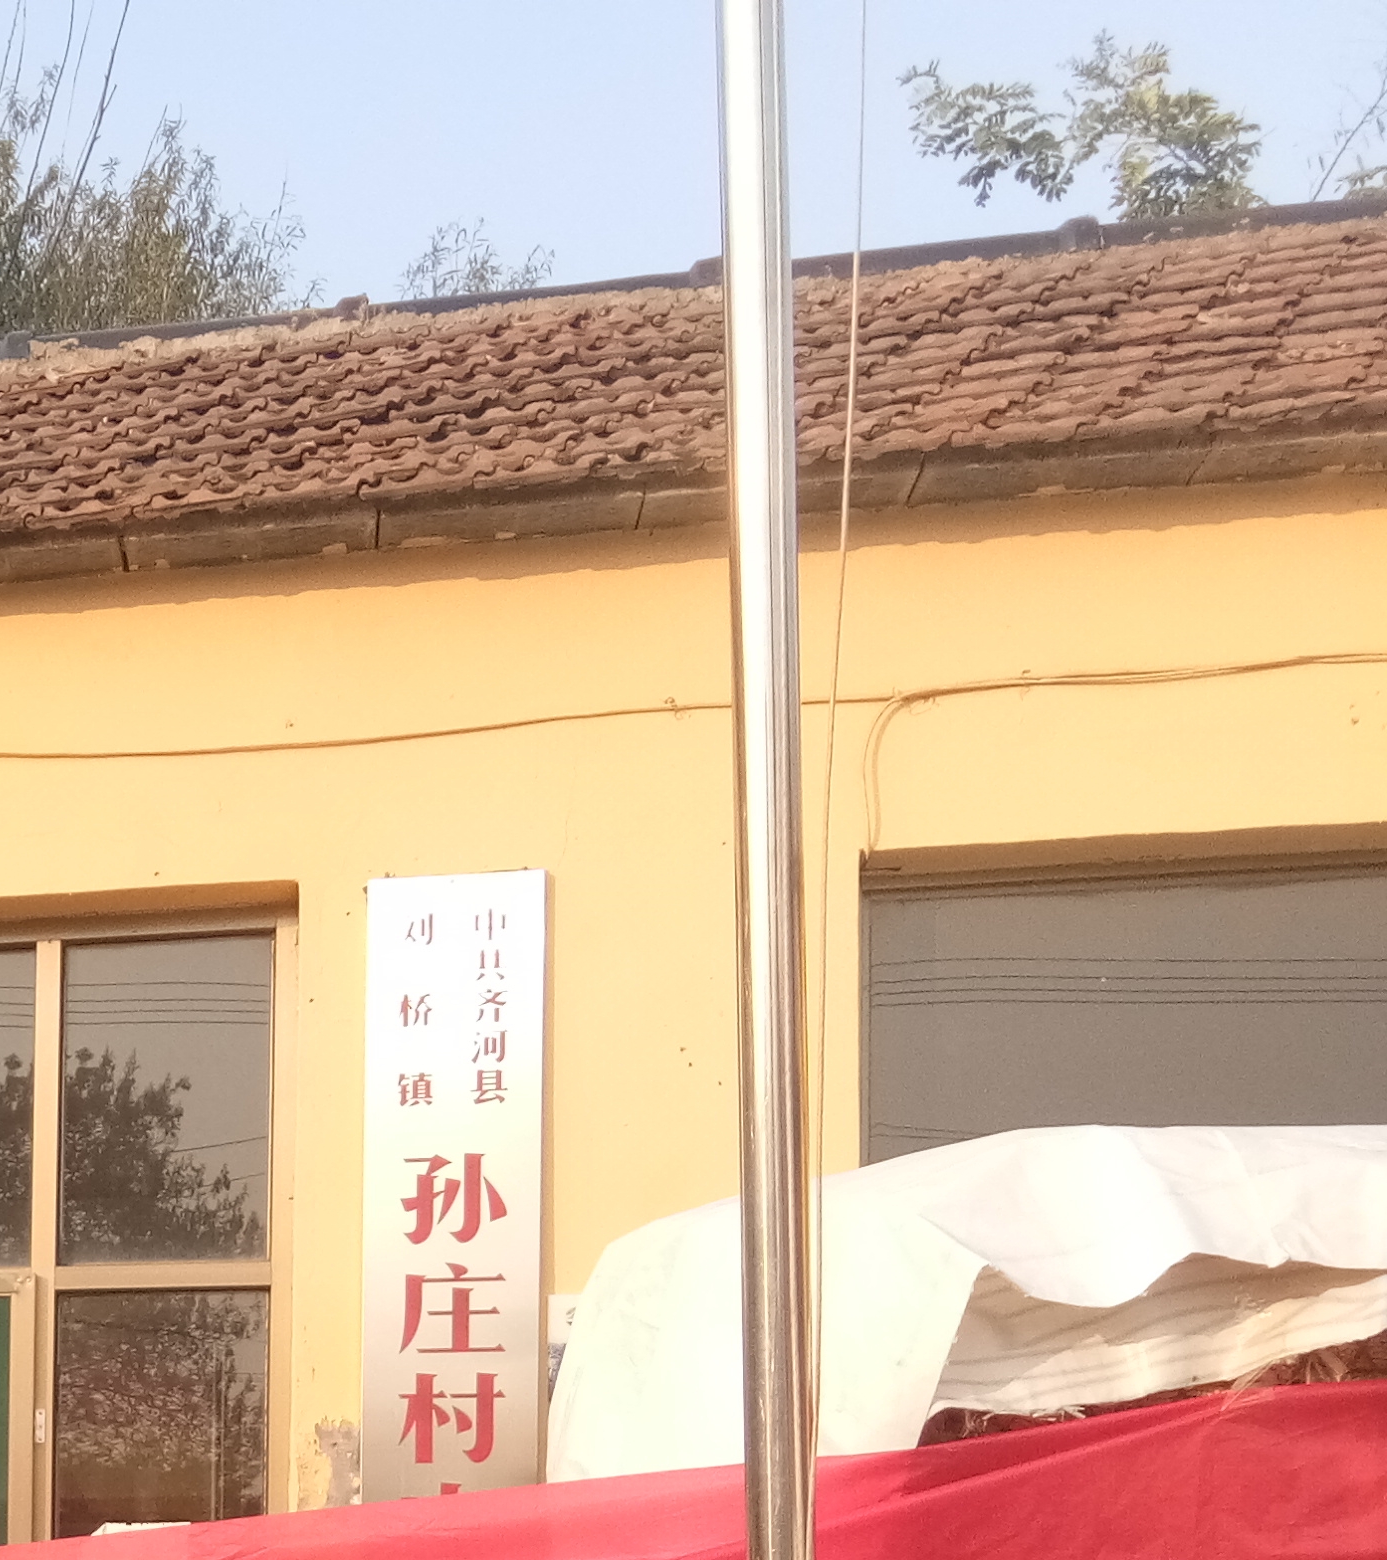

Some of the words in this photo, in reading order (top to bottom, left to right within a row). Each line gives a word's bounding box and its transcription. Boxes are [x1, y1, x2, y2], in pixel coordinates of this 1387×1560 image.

[397, 912, 434, 1107] 刘桥镇
[398, 1152, 508, 1499] 孙庄村
